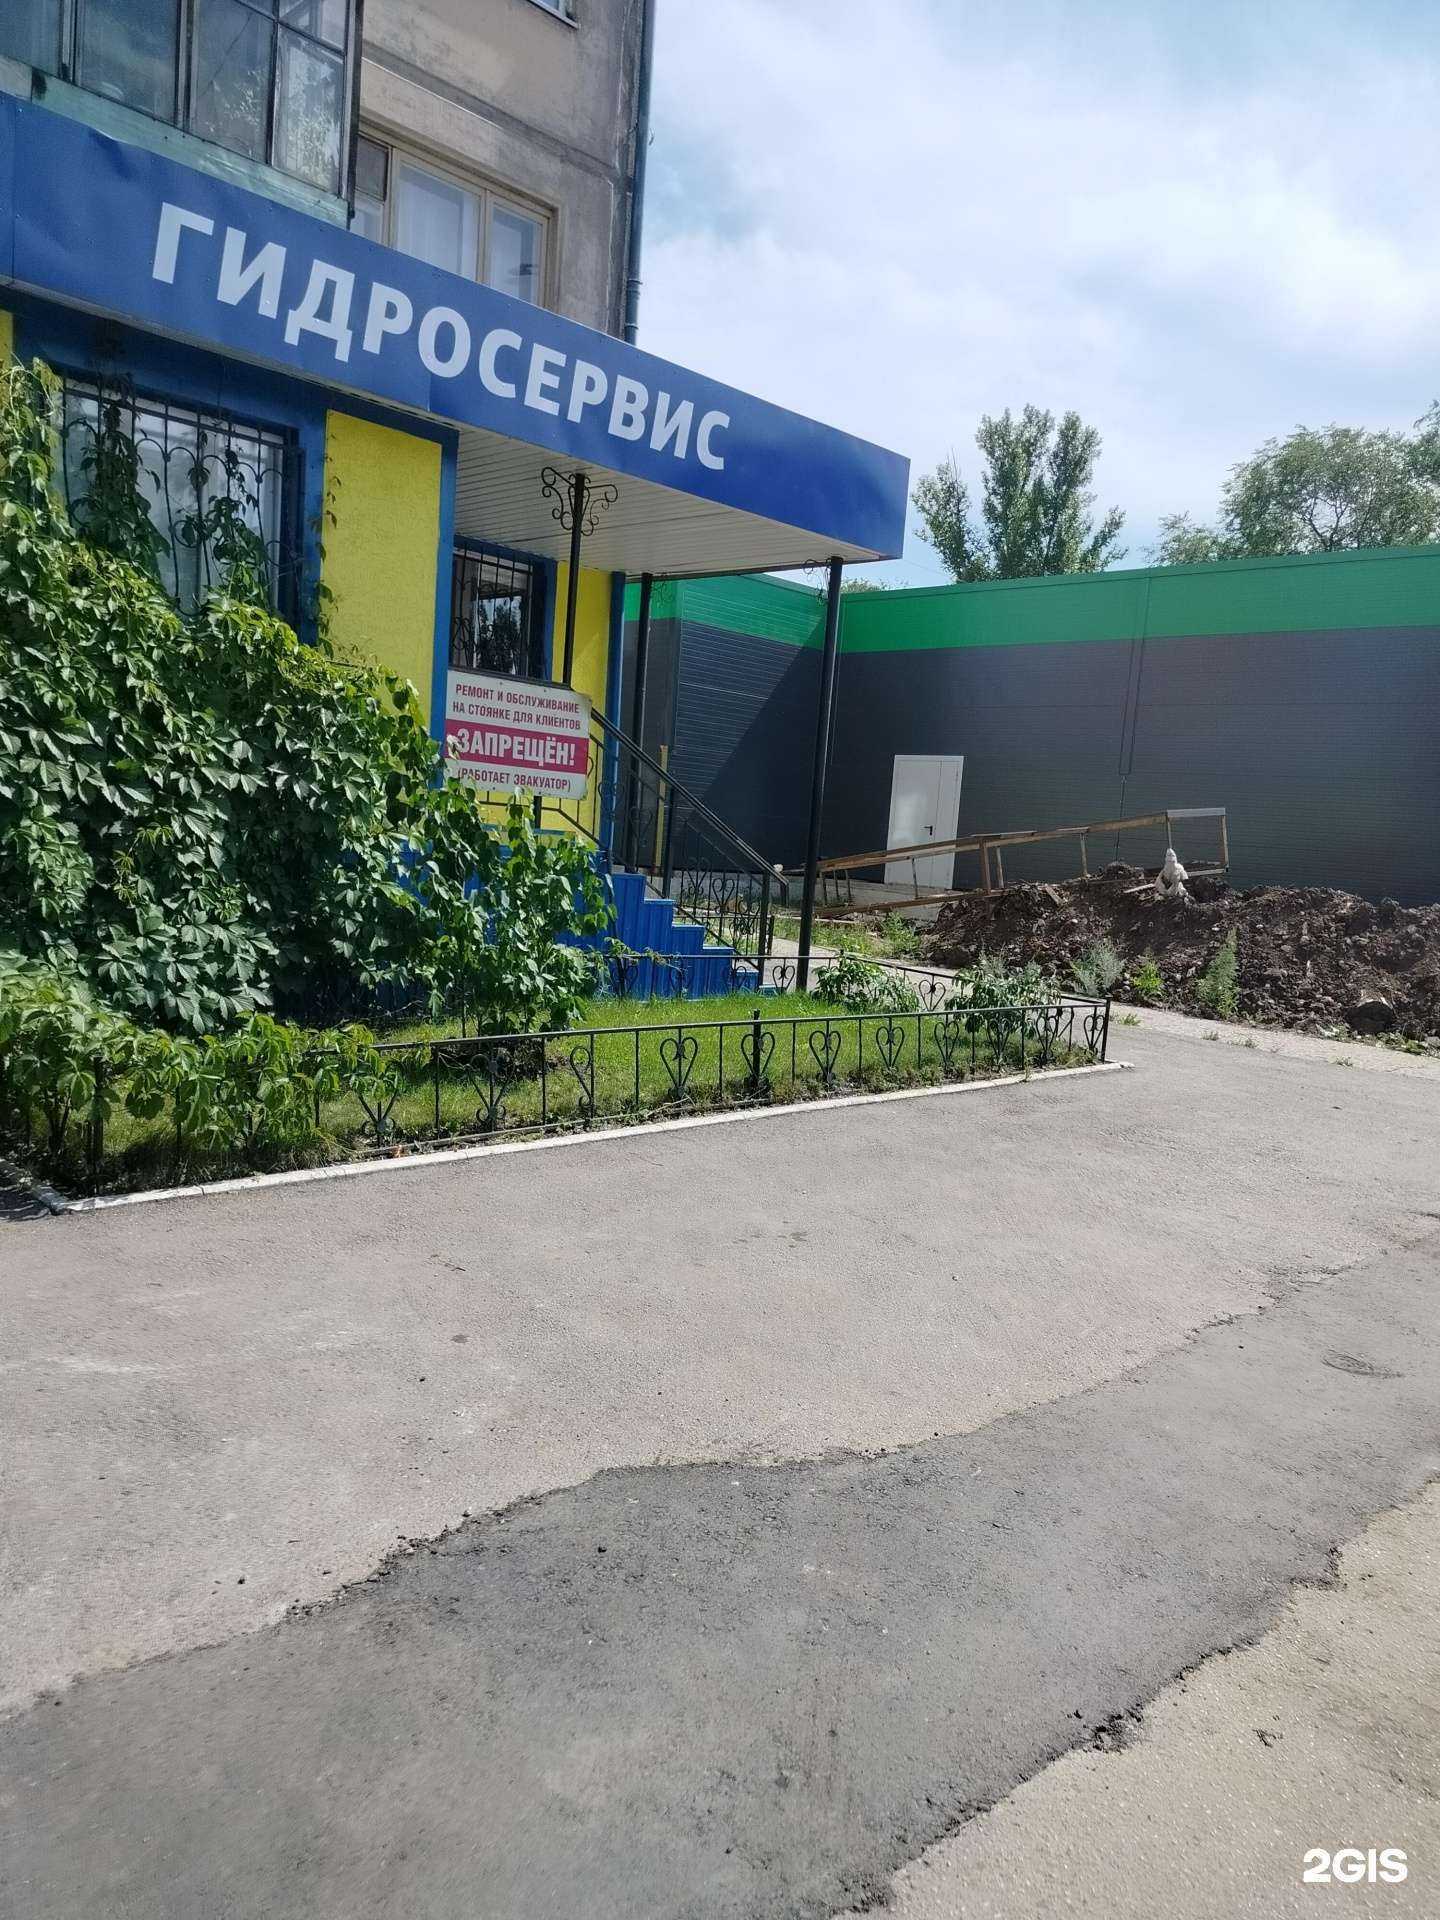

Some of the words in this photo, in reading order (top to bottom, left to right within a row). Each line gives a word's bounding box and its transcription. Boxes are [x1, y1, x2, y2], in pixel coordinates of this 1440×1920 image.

[152, 201, 731, 470] ГИДРОСЕРВИС
[455, 684, 494, 701] РЕМОНТ
[497, 689, 504, 701] И
[506, 692, 580, 713] ОБСЛУЖИВАНИЕ
[453, 701, 465, 713] НА
[468, 703, 511, 720] СТОЯНКЕ
[512, 711, 533, 724] ДЛЯ
[535, 716, 581, 730] КЛИЕНТОВ
[457, 728, 575, 767] ЗАПРЕЩЁН!
[513, 774, 571, 792] ЭВАКУАТОР)
